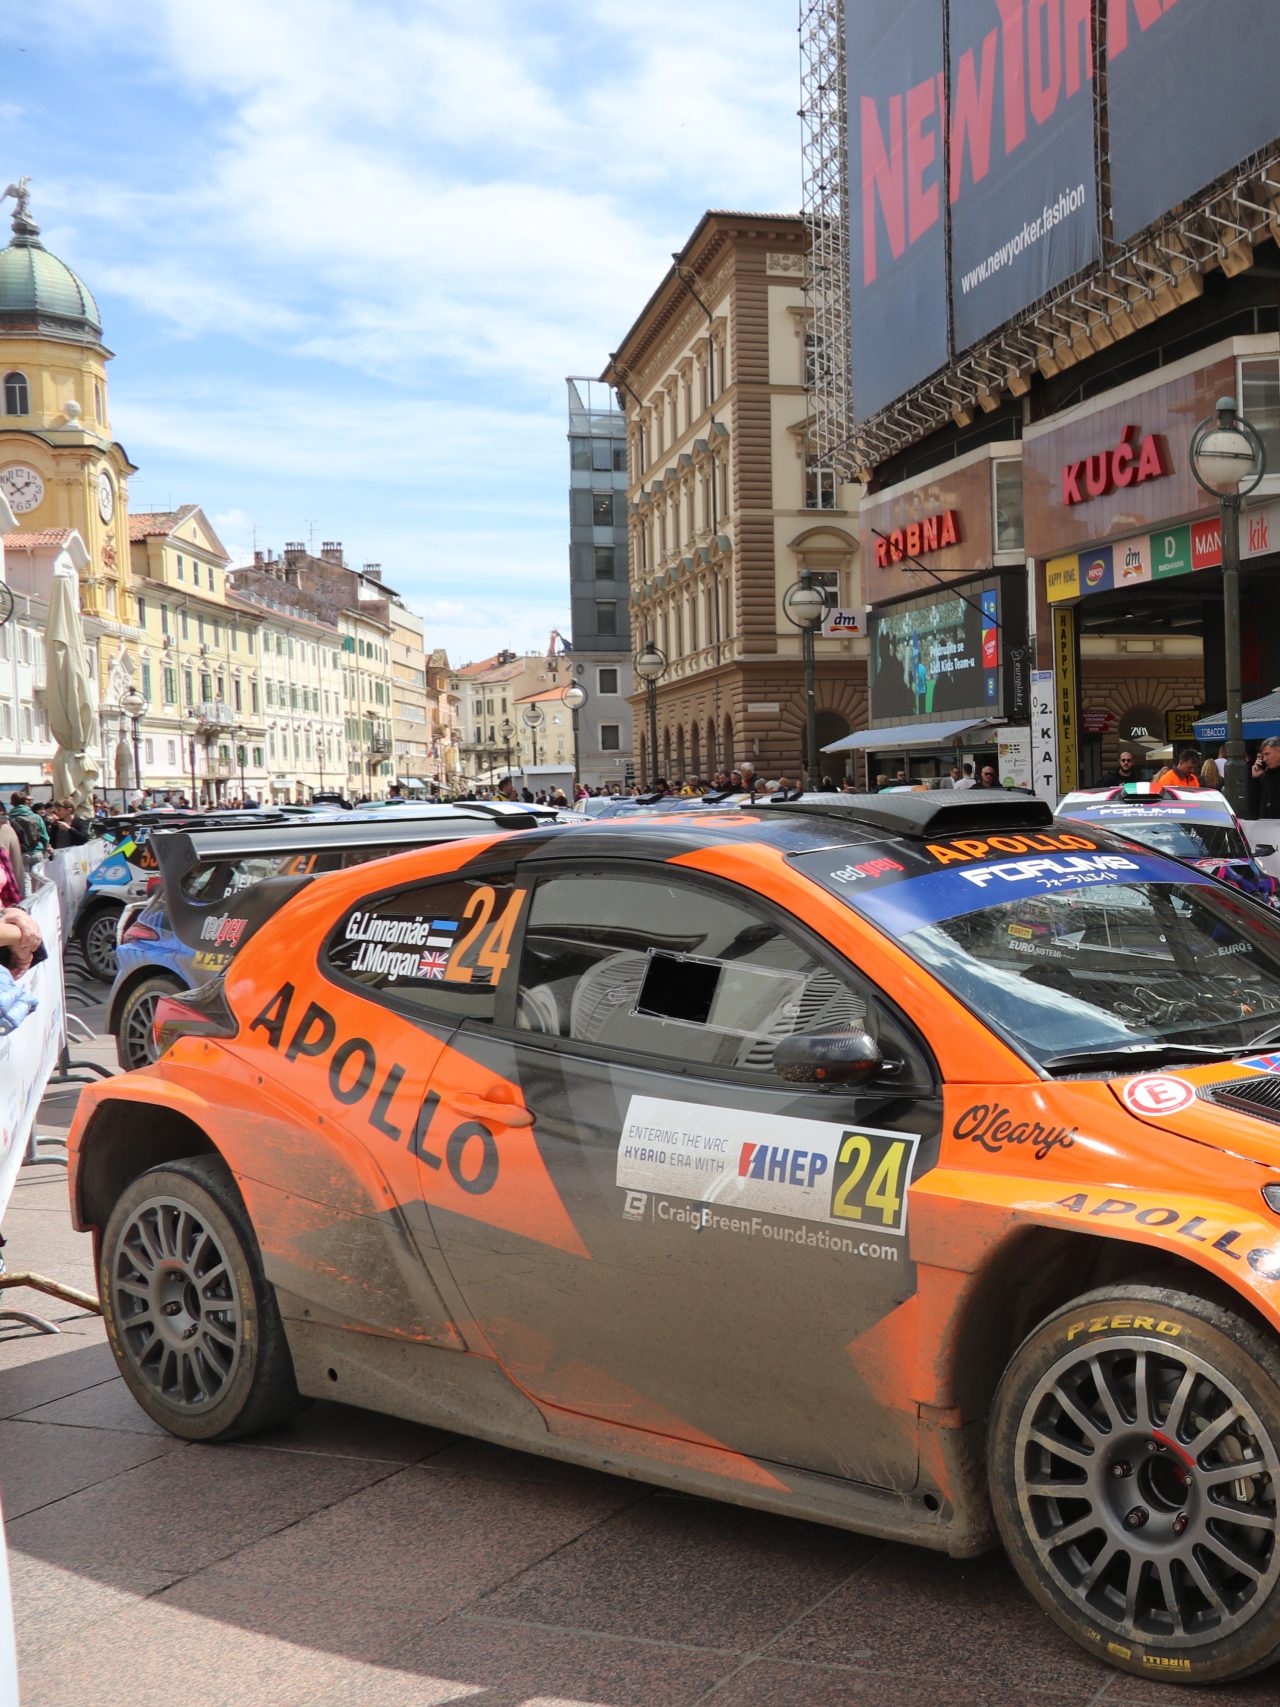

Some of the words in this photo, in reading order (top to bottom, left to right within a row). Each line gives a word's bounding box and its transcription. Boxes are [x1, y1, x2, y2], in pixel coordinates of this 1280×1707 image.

[961, 183, 1086, 294] www.newyorker.fashion
[1062, 424, 1173, 506] KUĆA
[874, 509, 961, 568] ROBNA
[1126, 544, 1141, 566] dm
[1195, 529, 1222, 555] MAN
[1048, 571, 1061, 588] HAPPY
[1063, 566, 1077, 584] HOME
[834, 612, 856, 627] dm
[1060, 615, 1068, 677] HAPPY
[1063, 688, 1072, 740] HOME
[1175, 713, 1199, 724] Otku
[1175, 724, 1193, 734] Zla
[1201, 727, 1226, 737] TOBACCO
[925, 833, 1097, 865] APOLLO
[830, 856, 905, 884] redgrey
[958, 855, 1140, 888] FORUM8
[200, 912, 248, 948] redgrey
[345, 911, 429, 946] G.Linnamäe
[444, 886, 527, 986] 24
[352, 943, 421, 981] J.Morgan
[1008, 939, 1034, 953] EURO
[1035, 947, 1061, 959] SISTEMI
[1218, 943, 1244, 957] EURO
[248, 981, 499, 1195] APOLLO
[1152, 1082, 1177, 1107] E
[628, 1125, 679, 1145] ENTERING
[681, 1132, 702, 1149] THE
[703, 1135, 728, 1153] WRC
[953, 1103, 1079, 1160] O'Learys
[625, 1146, 666, 1164] HYBRID
[670, 1152, 691, 1167] ERA
[695, 1157, 725, 1174] WITH
[768, 1146, 828, 1188] HEP
[833, 1135, 906, 1225] 24
[657, 1200, 898, 1262] CraigBreenFoundation.com
